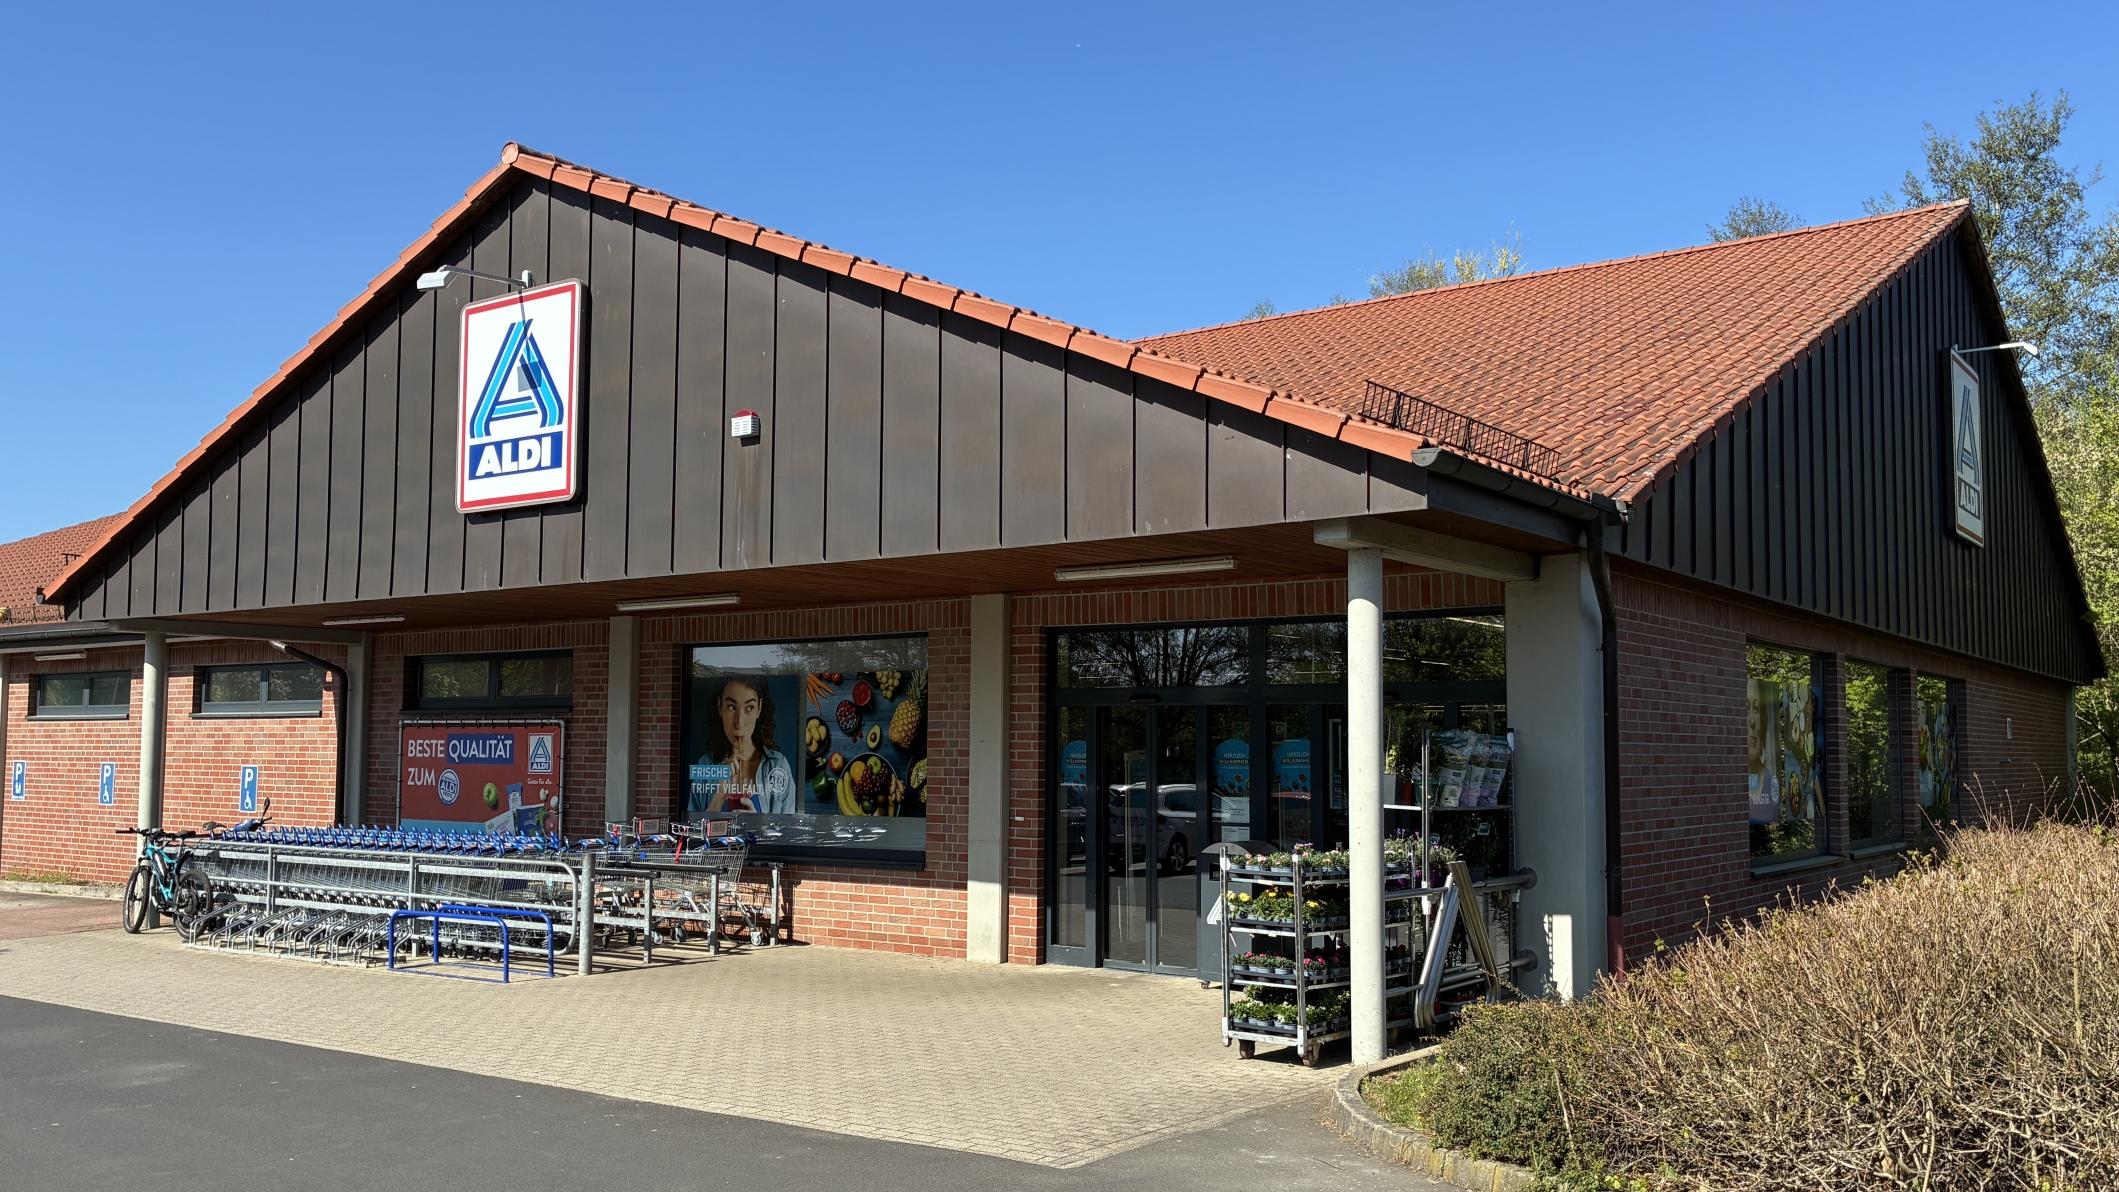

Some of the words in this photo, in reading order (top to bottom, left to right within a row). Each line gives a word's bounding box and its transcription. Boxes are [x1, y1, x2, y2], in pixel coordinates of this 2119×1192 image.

[475, 436, 552, 477] ALDI
[1959, 482, 1979, 517] ALDI
[408, 739, 445, 758] BESTE
[448, 735, 512, 762] QUALITÄT
[15, 762, 23, 780] P
[103, 764, 111, 784] P
[532, 762, 549, 770] ALDI
[692, 767, 728, 778] FRISCHE
[244, 768, 254, 789] P
[407, 768, 435, 786] ZUM
[440, 781, 457, 794] ALDI
[691, 783, 721, 794] TRIFFT
